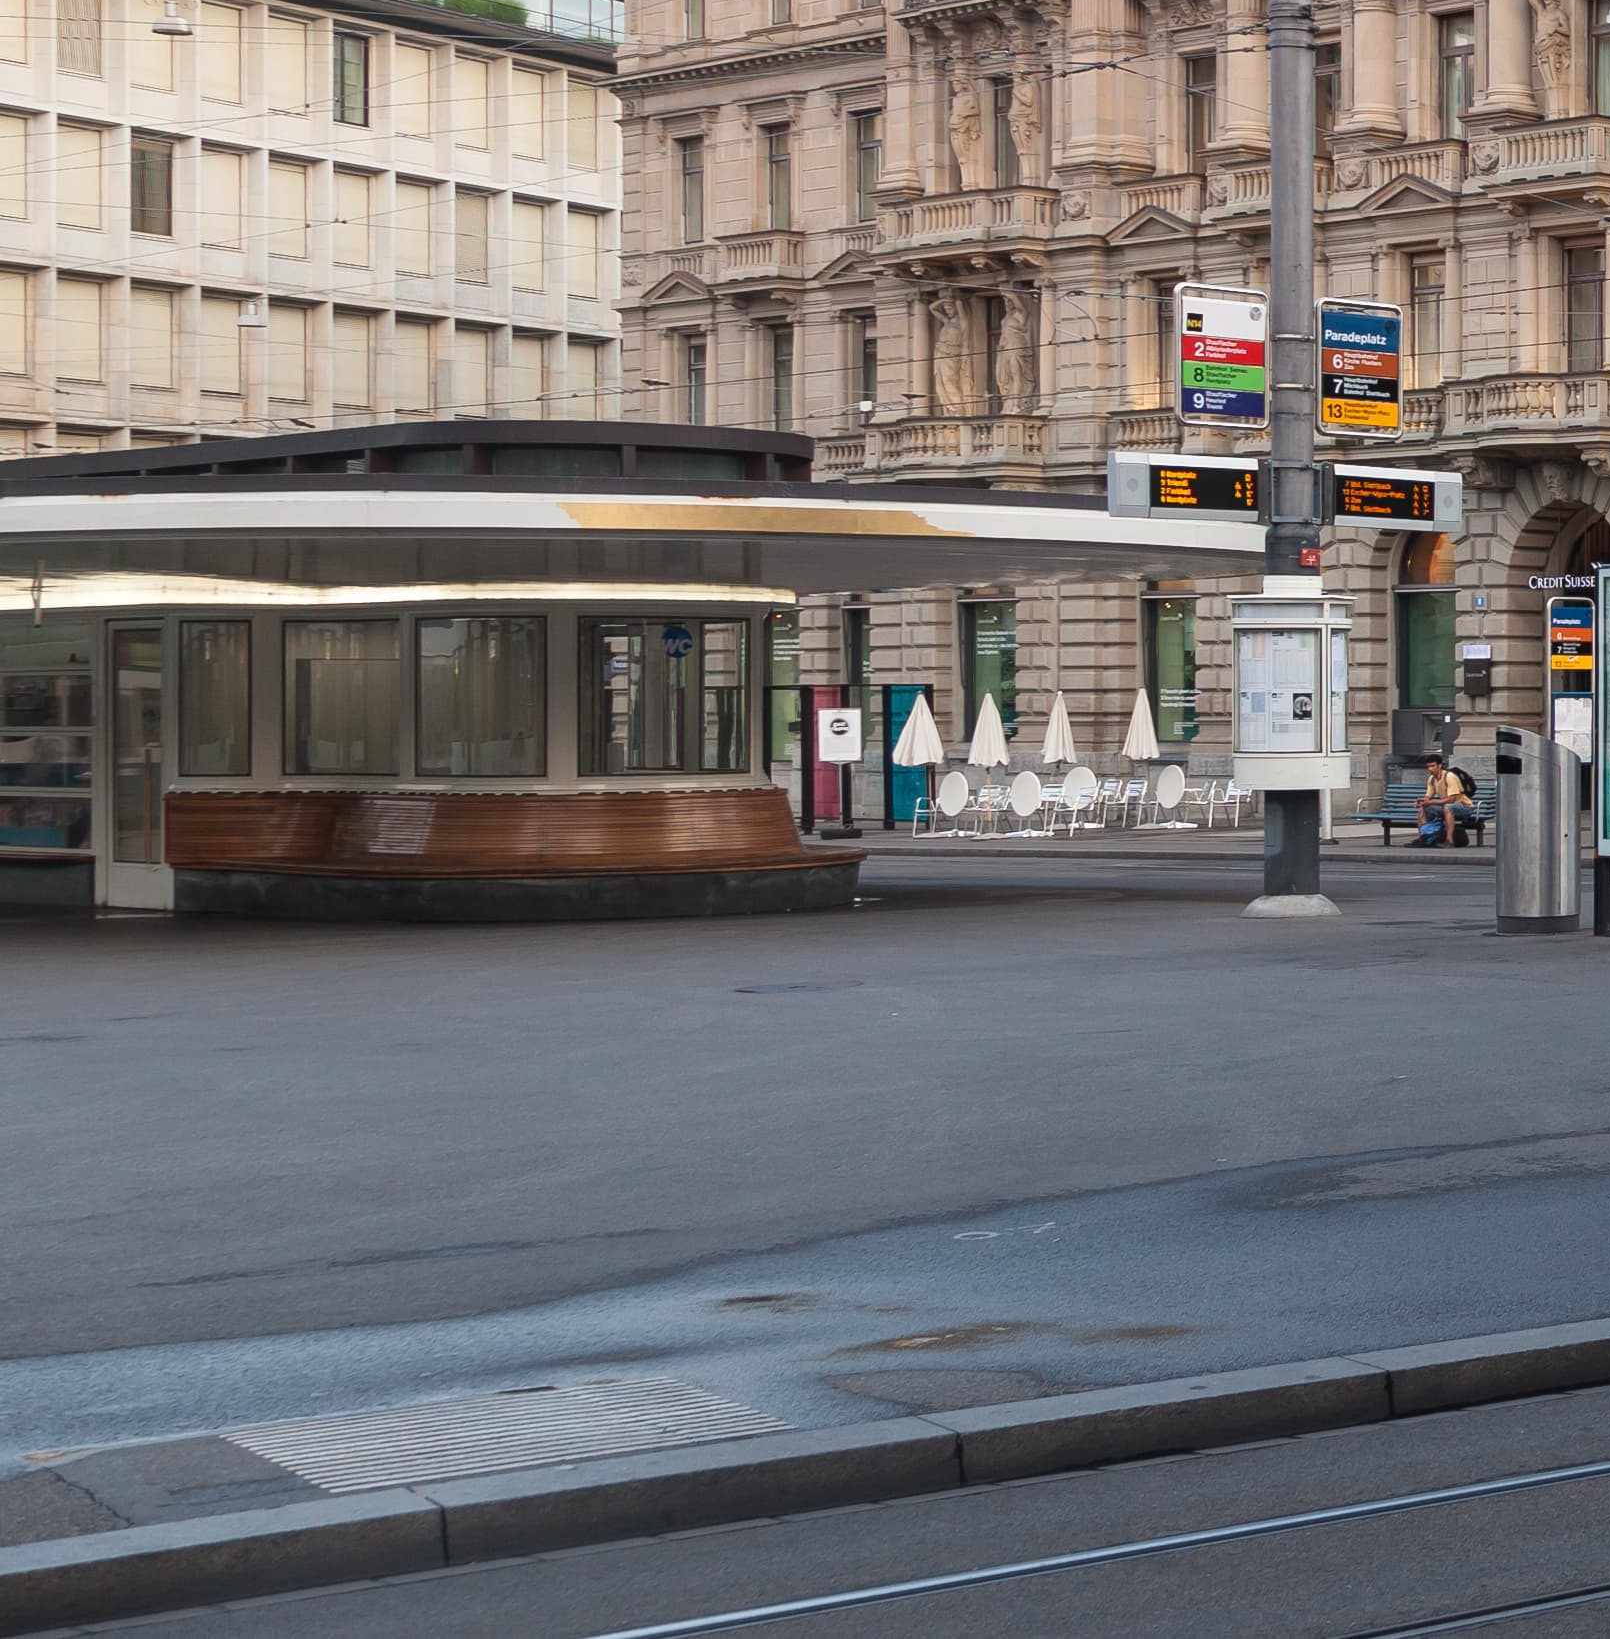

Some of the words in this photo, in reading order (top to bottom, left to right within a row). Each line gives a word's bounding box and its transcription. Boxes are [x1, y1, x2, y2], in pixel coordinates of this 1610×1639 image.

[1325, 329, 1387, 345] Paradeplatz
[1194, 341, 1205, 357] 2
[1333, 354, 1343, 369] 6
[1193, 367, 1204, 383] 8
[1333, 378, 1343, 394] 7
[1193, 393, 1204, 409] 9
[1327, 403, 1343, 419] 13
[1528, 575, 1564, 590] CREDIT
[1564, 574, 1596, 589] SUISSE
[663, 638, 692, 654] WC
